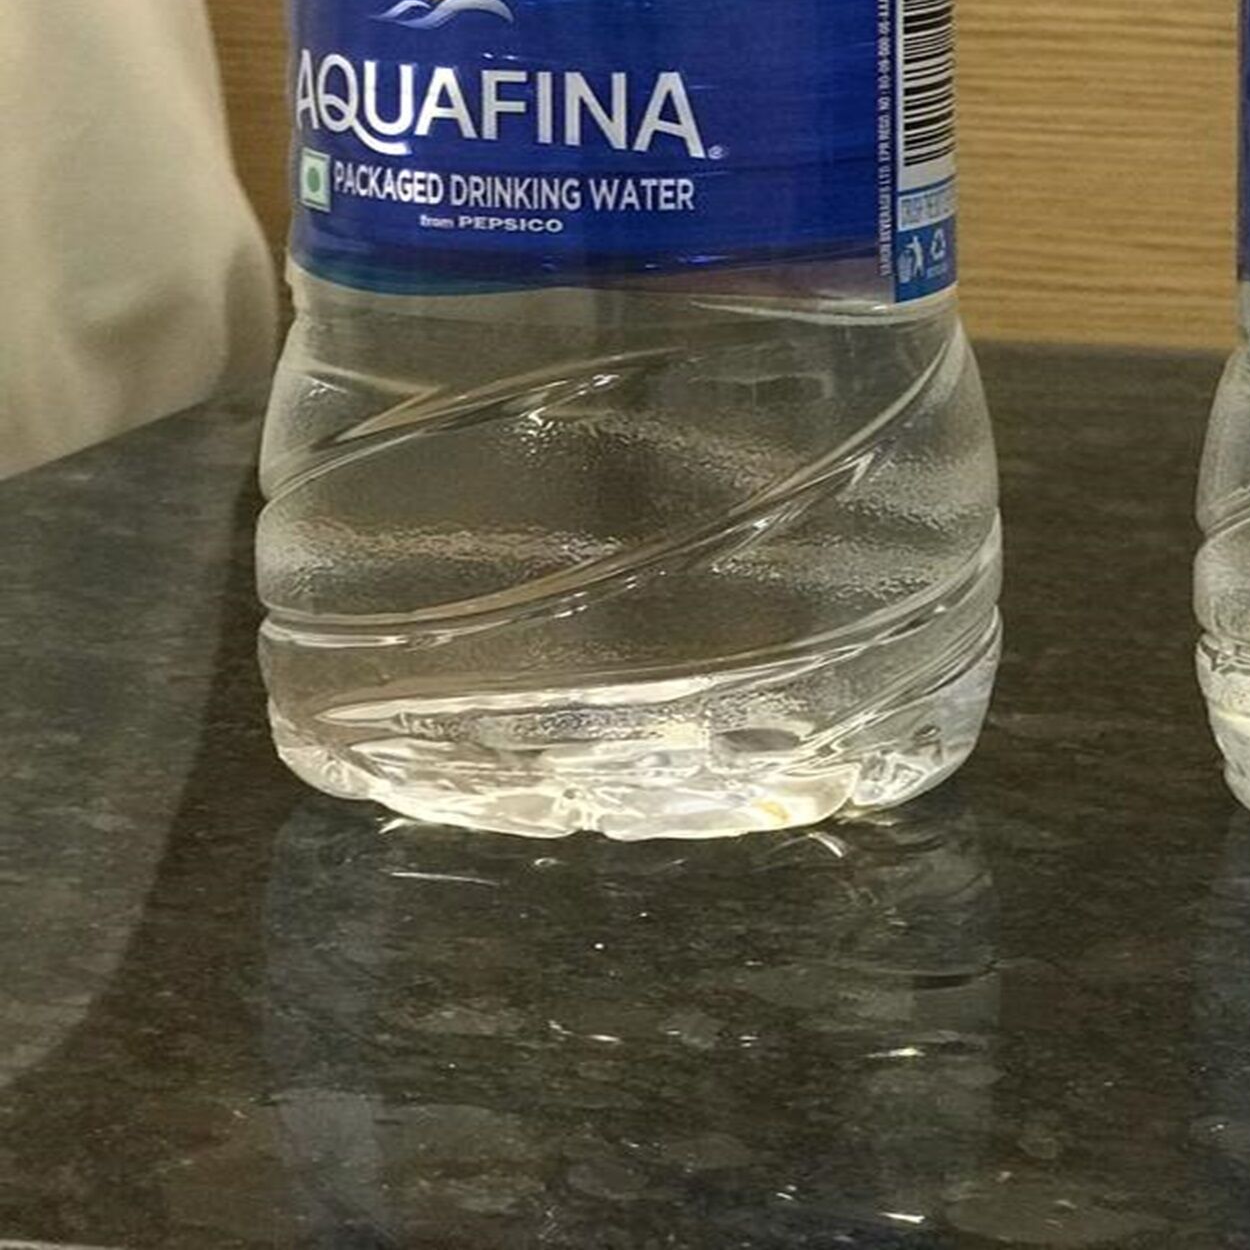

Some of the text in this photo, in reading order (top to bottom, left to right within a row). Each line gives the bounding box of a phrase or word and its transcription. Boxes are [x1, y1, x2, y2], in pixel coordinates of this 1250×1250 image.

[334, 160, 696, 211] PACKAGED DRINKING WATER
[419, 214, 564, 233] from PEPSICO
